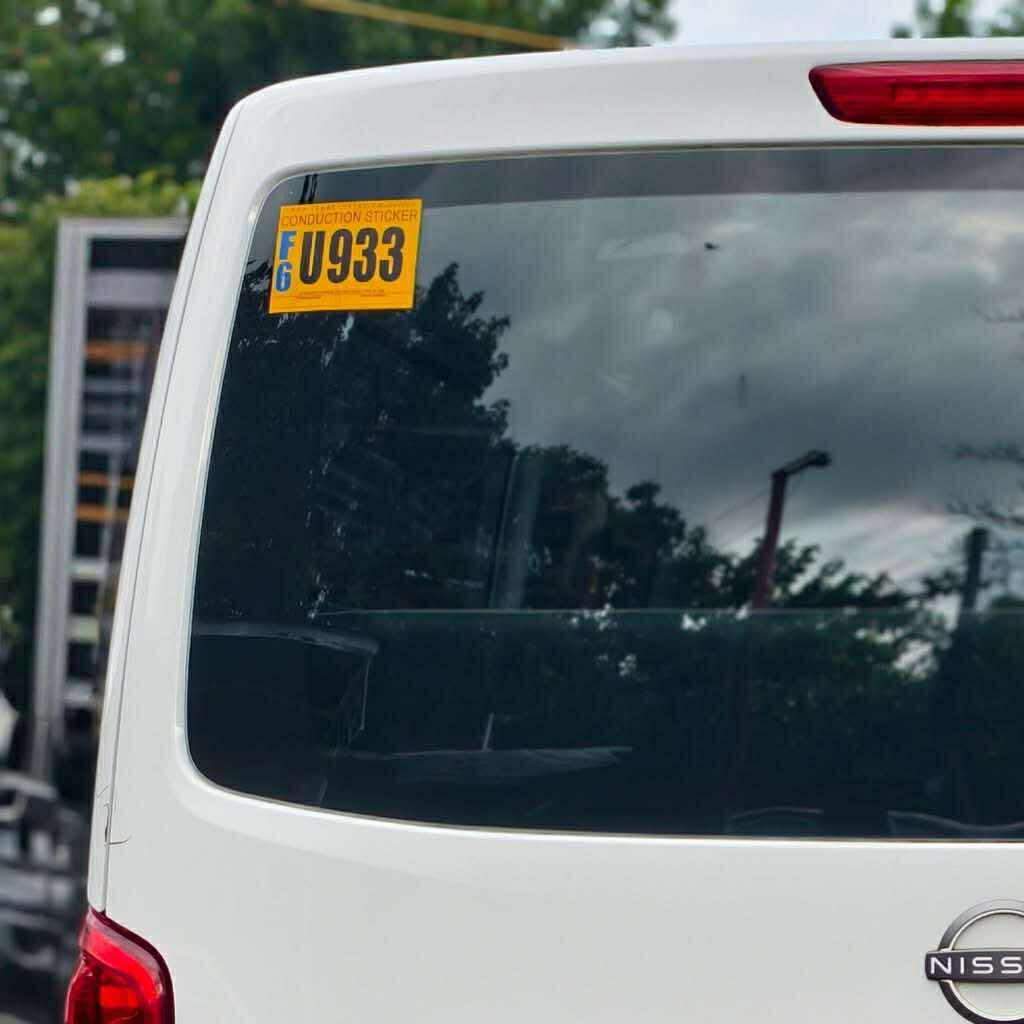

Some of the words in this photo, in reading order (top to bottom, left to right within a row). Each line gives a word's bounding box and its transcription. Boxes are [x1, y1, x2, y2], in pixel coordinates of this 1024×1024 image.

[281, 211, 362, 226] CONDUCTION
[365, 209, 418, 223] STICKER
[300, 227, 406, 285] U933
